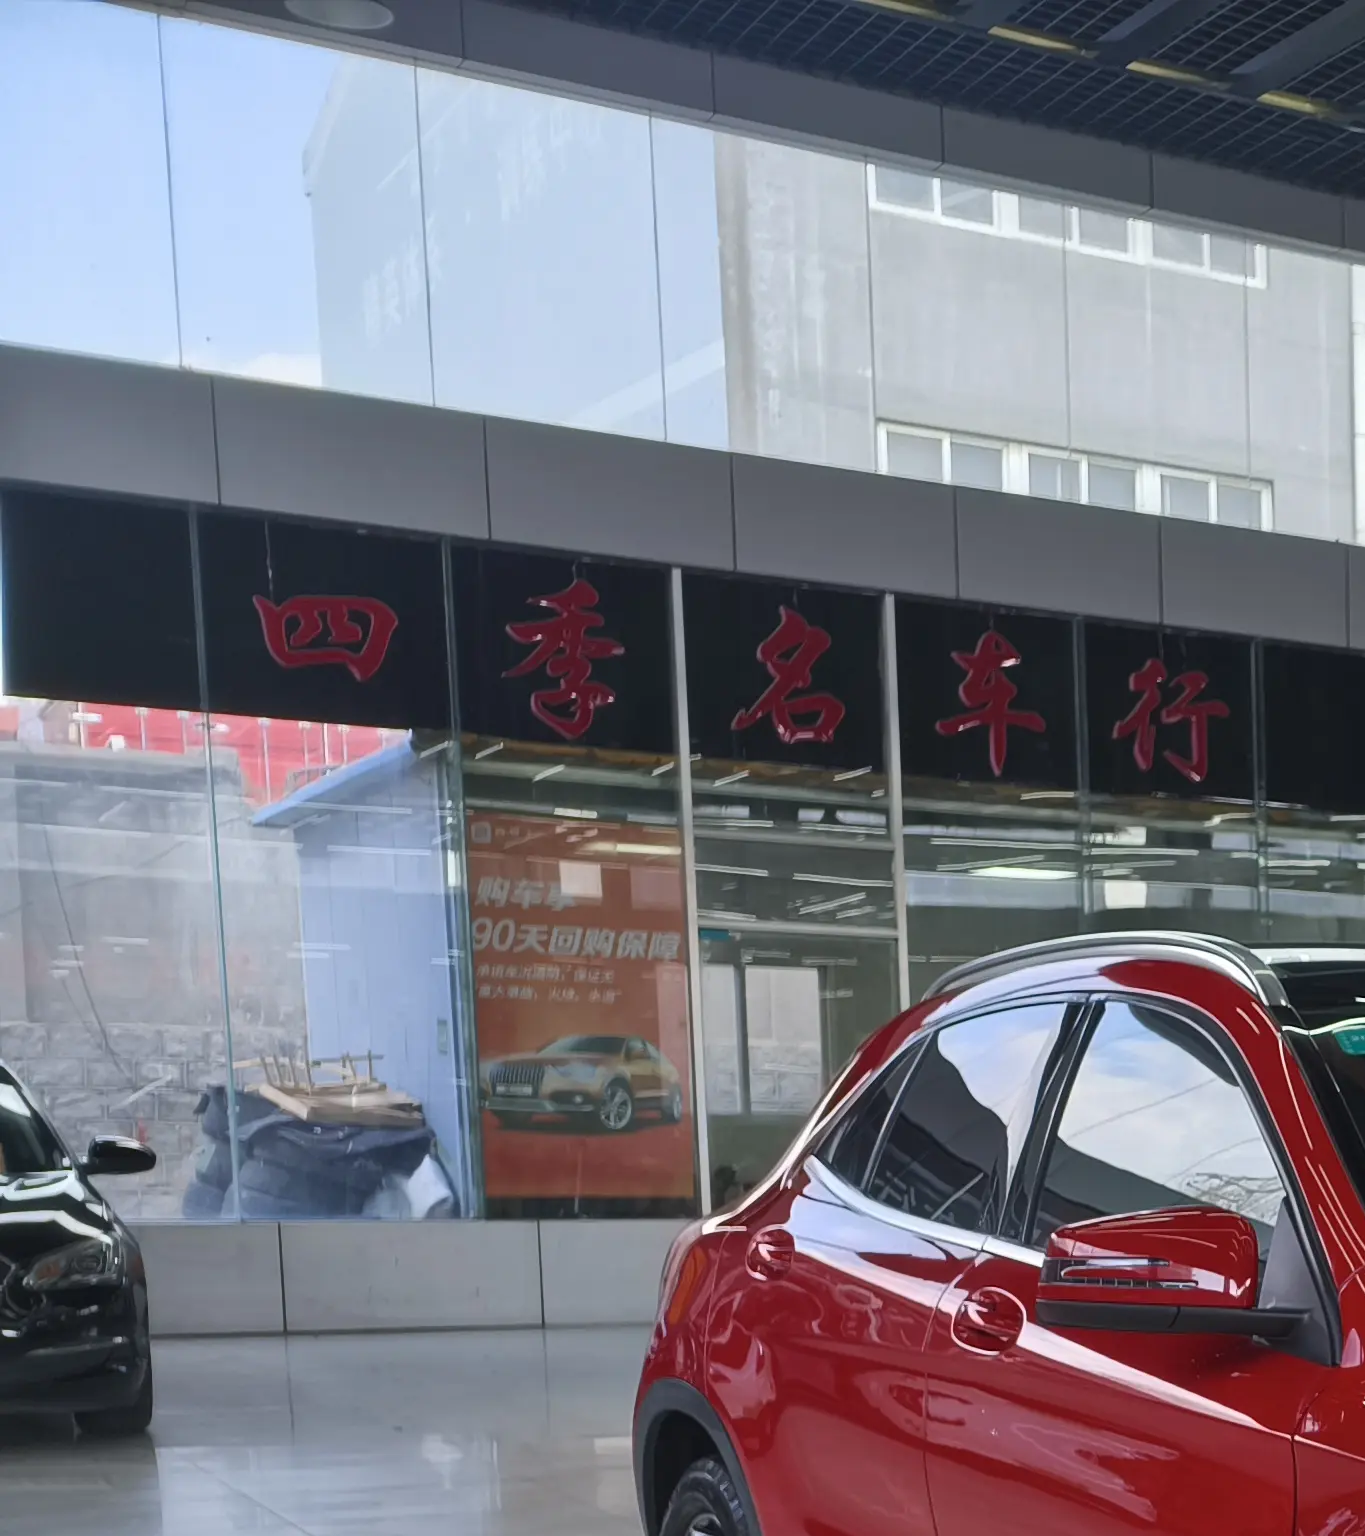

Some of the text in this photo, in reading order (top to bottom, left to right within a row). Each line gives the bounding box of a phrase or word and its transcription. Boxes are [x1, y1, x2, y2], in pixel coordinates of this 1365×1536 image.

[252, 577, 1231, 782] 四季名车行
[471, 917, 682, 961] 90天回购保障
